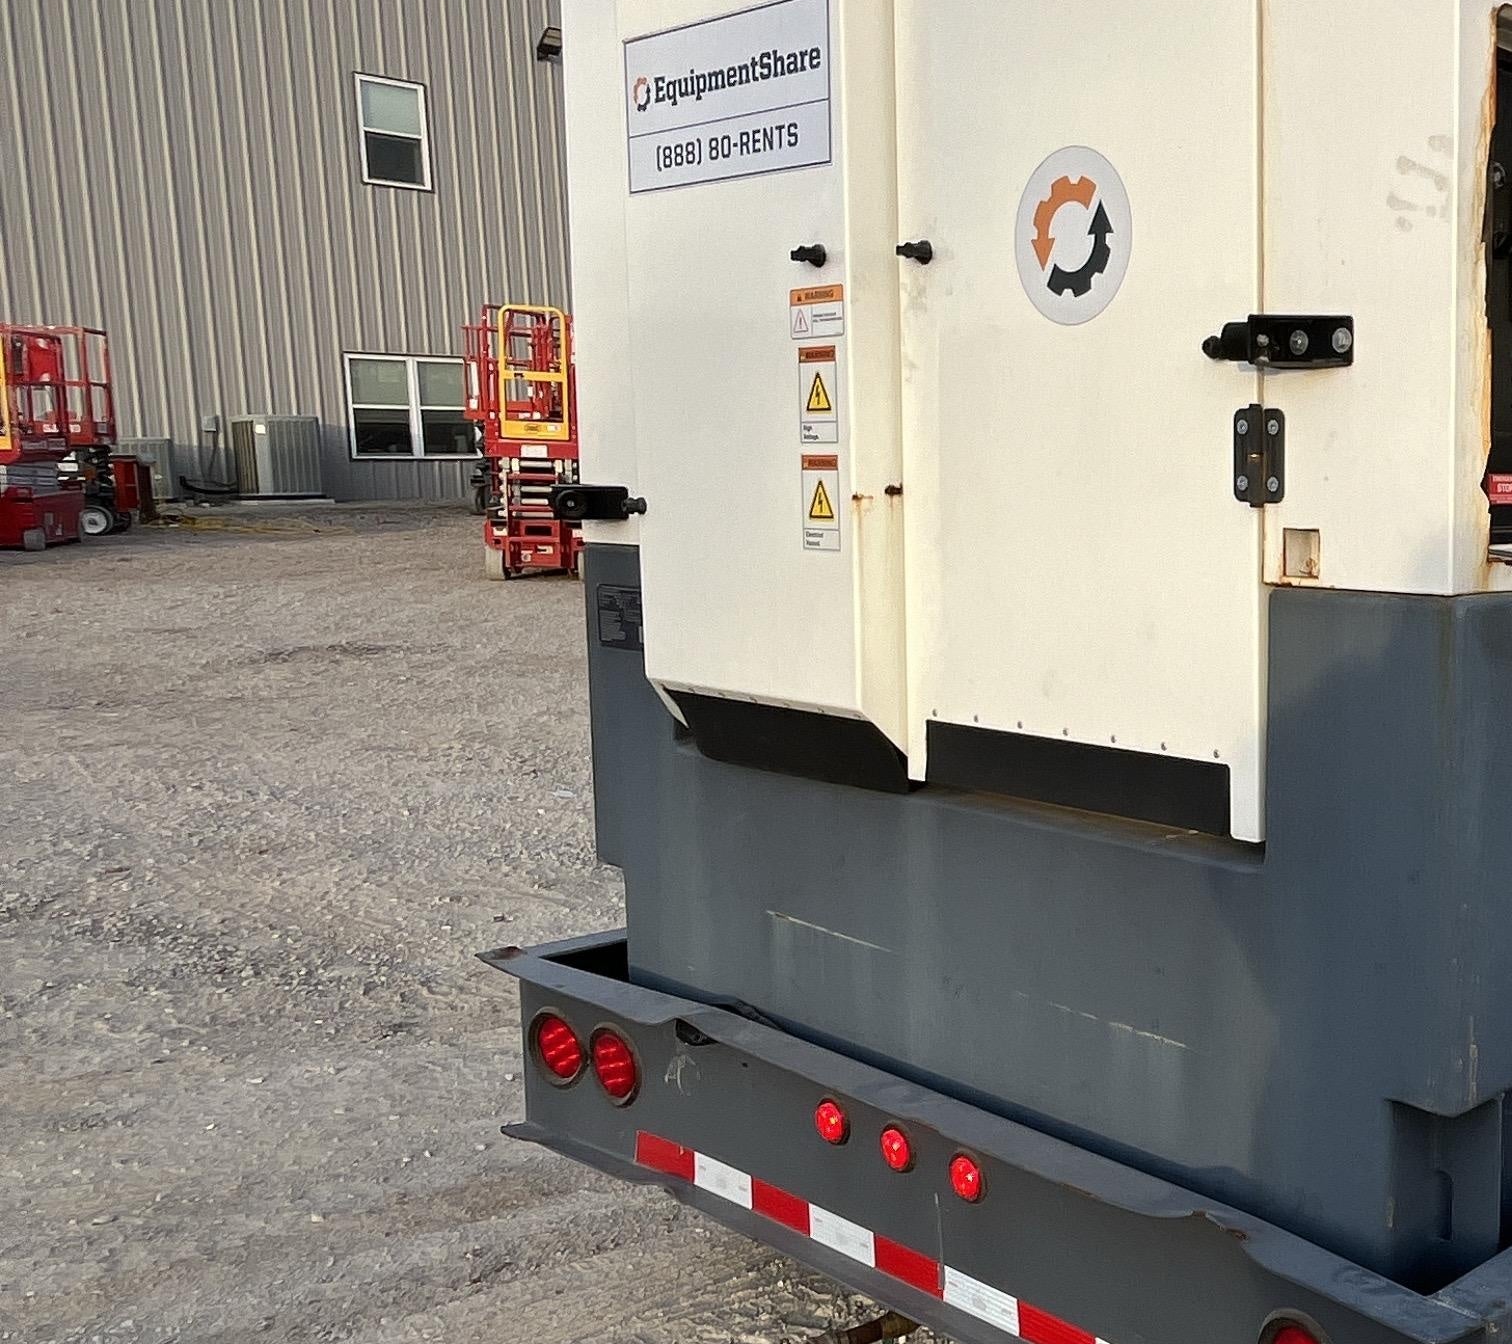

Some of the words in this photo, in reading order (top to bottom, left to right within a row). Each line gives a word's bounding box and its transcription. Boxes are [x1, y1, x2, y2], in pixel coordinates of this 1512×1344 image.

[654, 46, 821, 106] EquipmentShare
[656, 138, 702, 172] (888)
[709, 122, 799, 161] 80-RENTS
